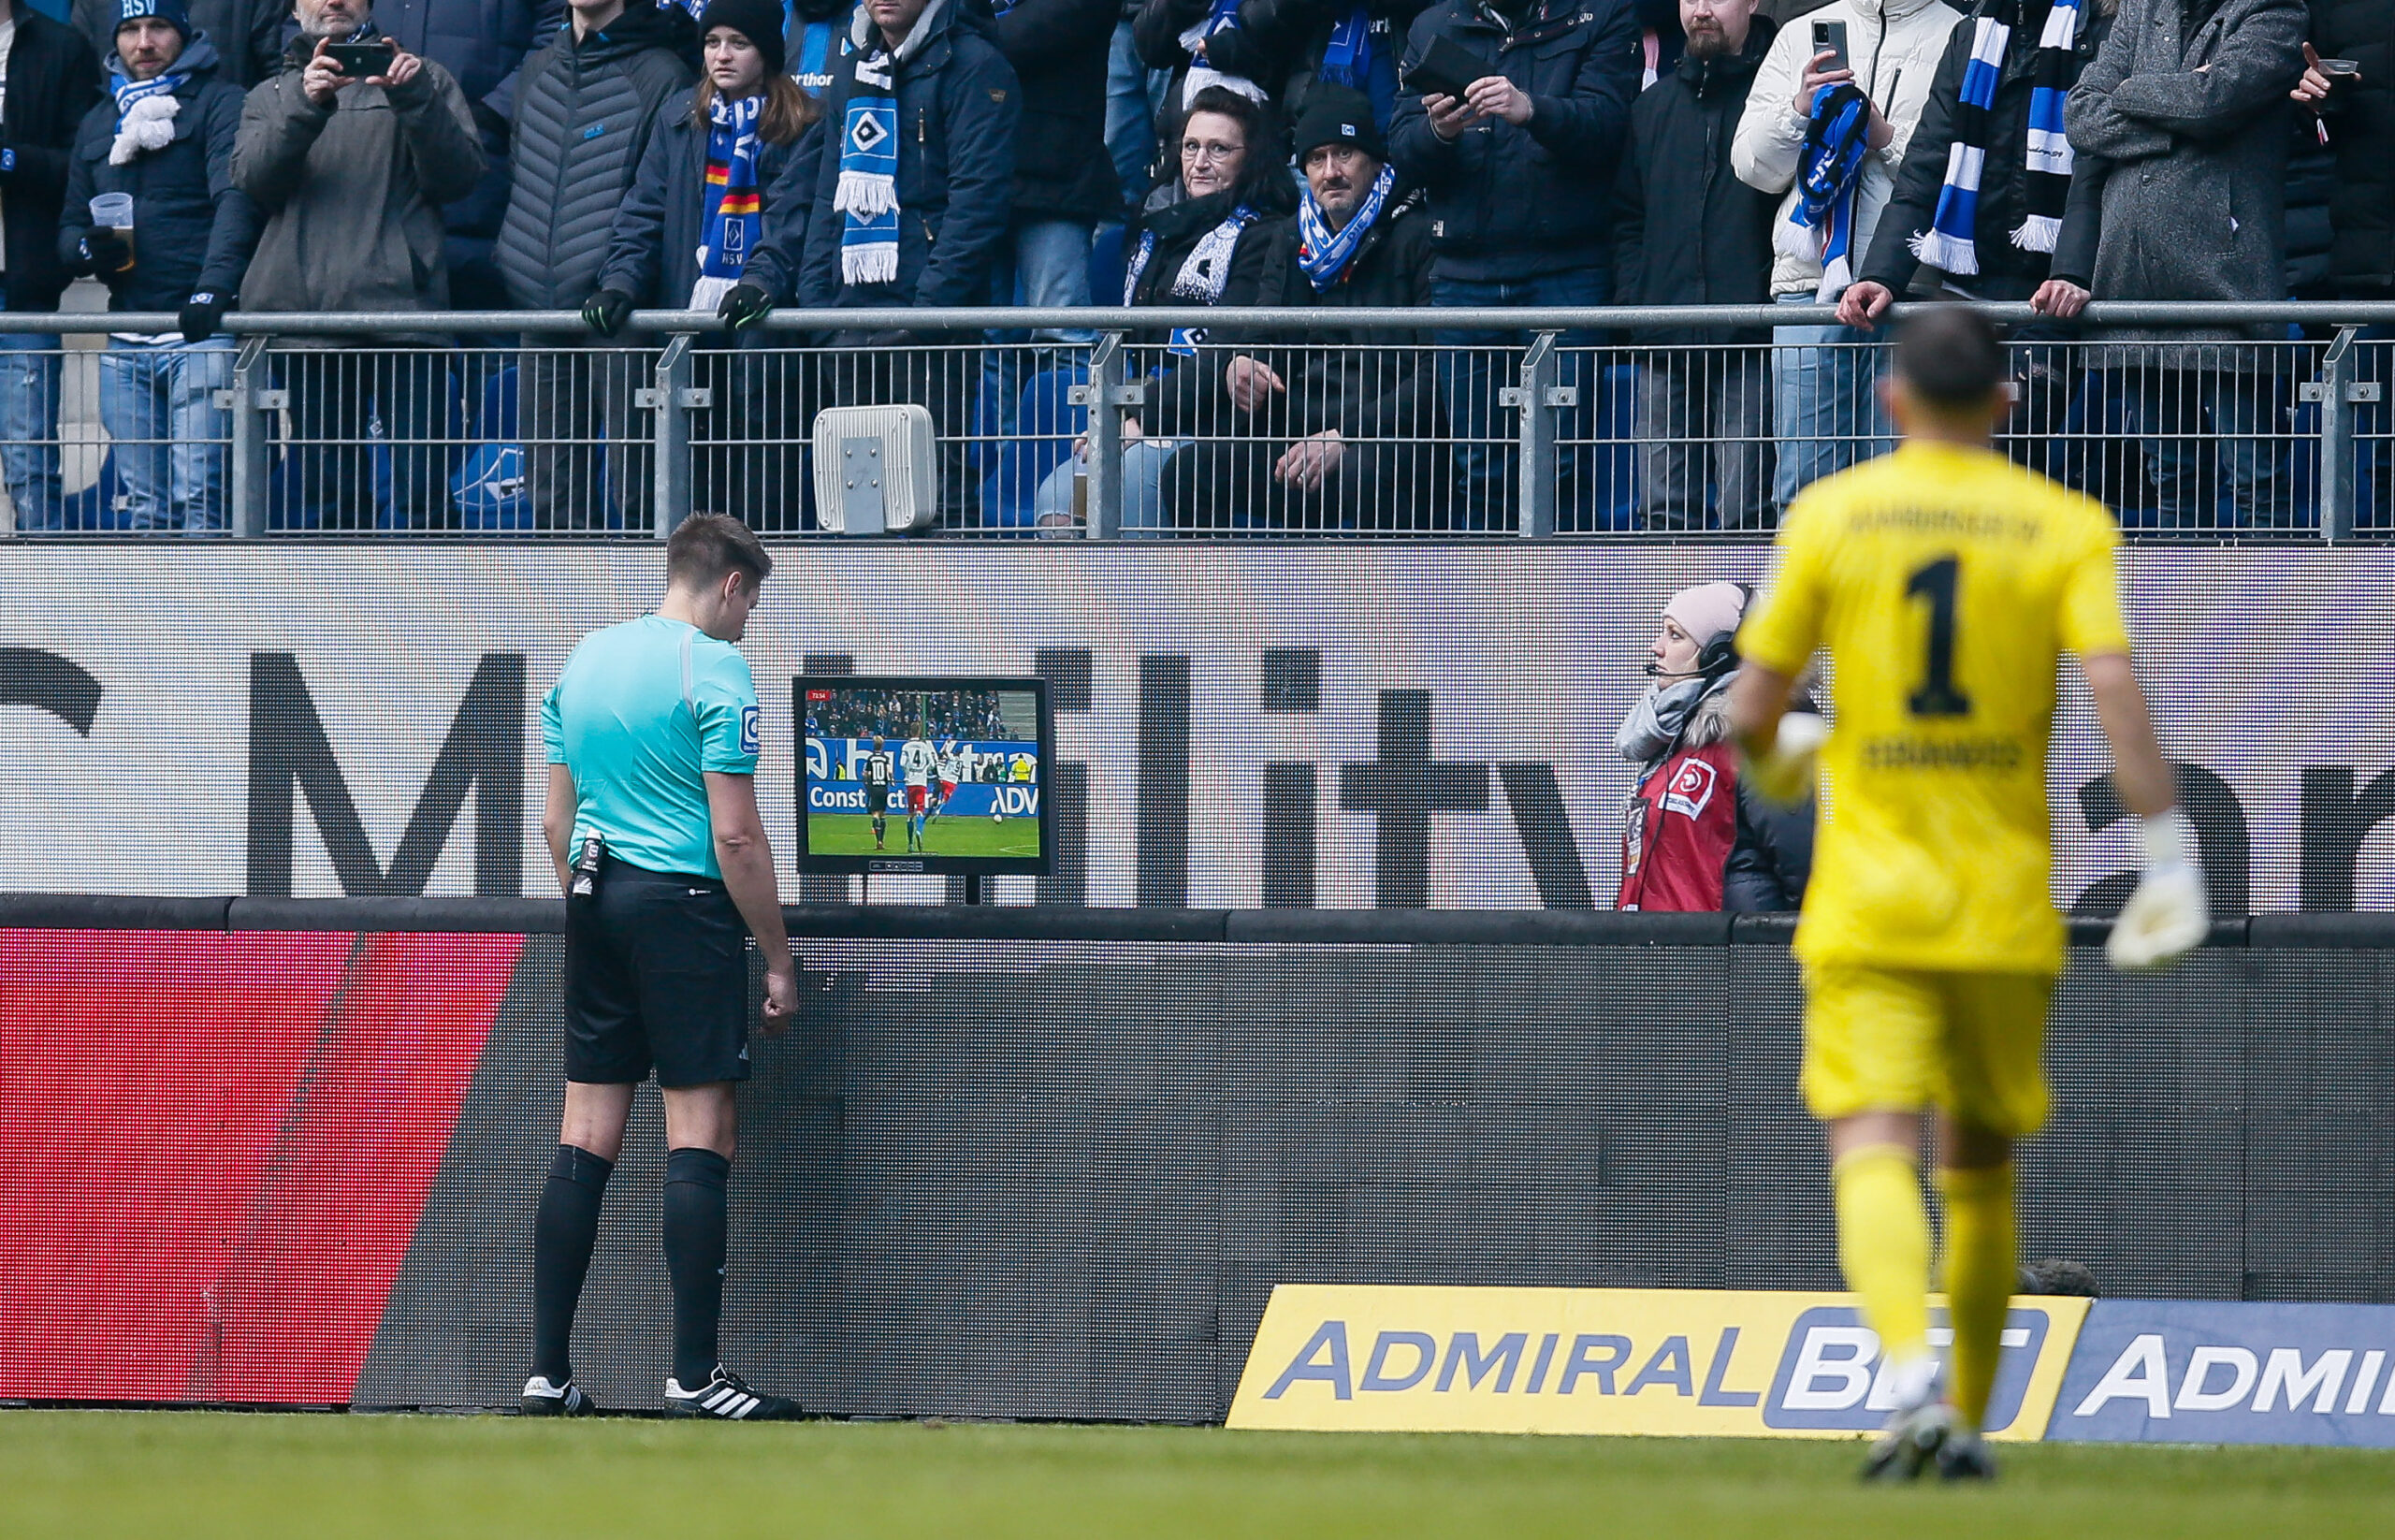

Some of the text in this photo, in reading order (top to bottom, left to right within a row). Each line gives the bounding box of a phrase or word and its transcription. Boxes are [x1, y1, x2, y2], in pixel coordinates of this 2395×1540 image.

[123, 0, 155, 18] HSV
[721, 252, 743, 265] HSV
[1904, 550, 1974, 718] 1
[913, 748, 923, 768] 4
[871, 762, 886, 780] 10
[1261, 1319, 1763, 1408] ADMIRAL
[2071, 1333, 2395, 1419] ADMI
